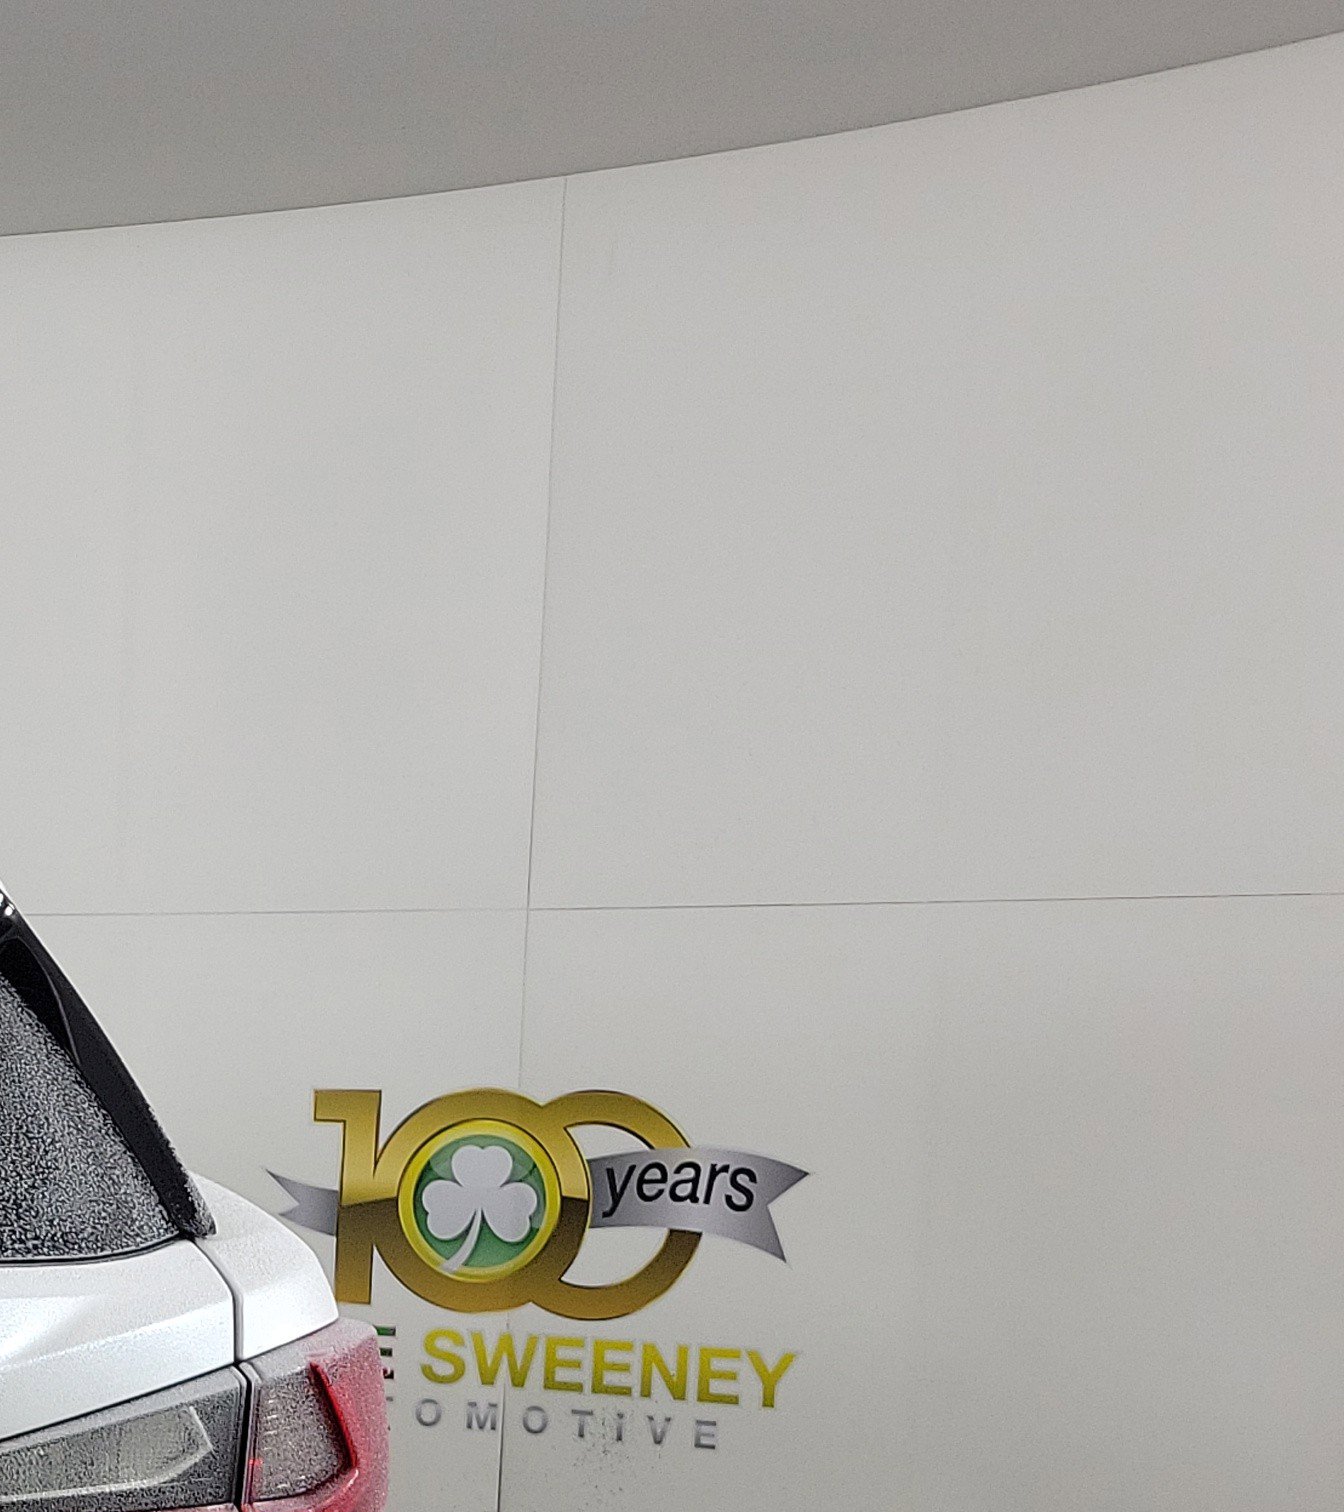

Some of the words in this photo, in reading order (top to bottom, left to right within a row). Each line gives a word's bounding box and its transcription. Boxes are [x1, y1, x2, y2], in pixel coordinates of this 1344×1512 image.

[313, 1087, 703, 1320] 100
[601, 1160, 758, 1218] years
[420, 1328, 799, 1408] SWEENEY
[385, 1395, 718, 1450] OMOTIVE
